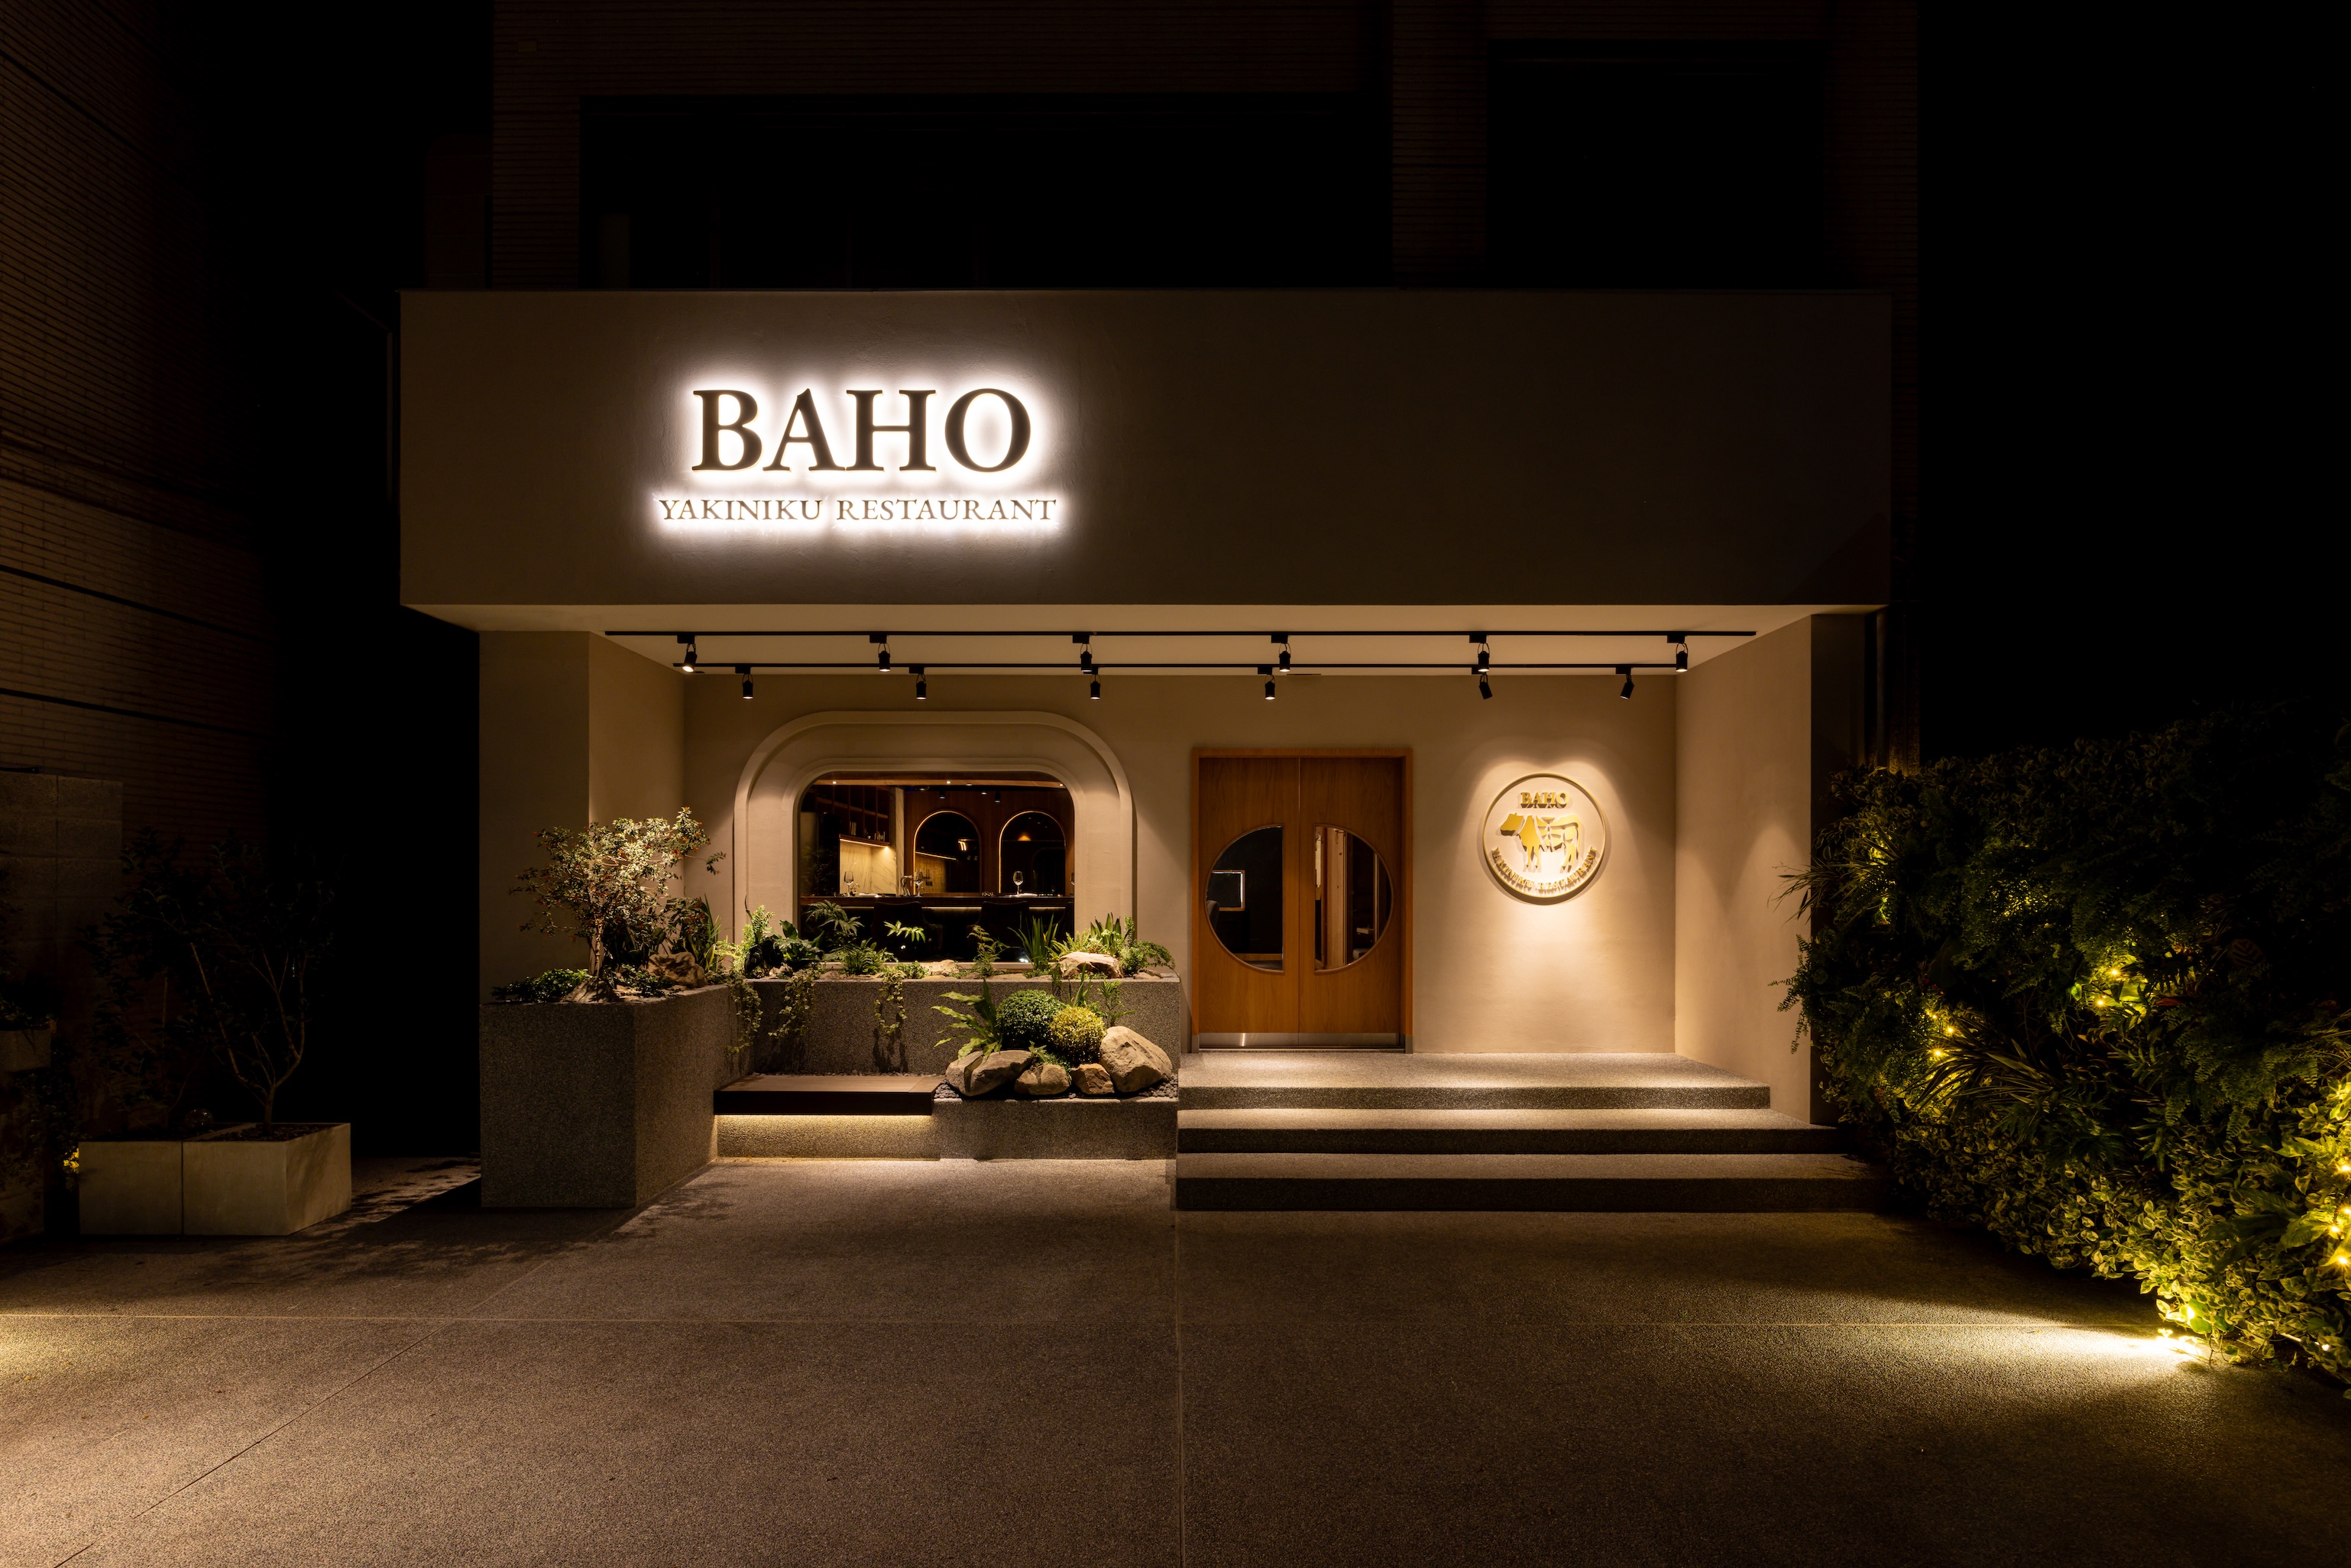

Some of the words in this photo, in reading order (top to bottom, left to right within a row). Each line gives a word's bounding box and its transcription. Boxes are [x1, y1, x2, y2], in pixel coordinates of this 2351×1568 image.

[691, 387, 1031, 472] BAHO
[659, 499, 823, 520] YAKINIKU
[836, 499, 1057, 520] RESTAURANT
[1520, 792, 1569, 807] BAHO
[1491, 847, 1533, 889] YAKINIKU
[1539, 847, 1598, 890] RESTAURANT
